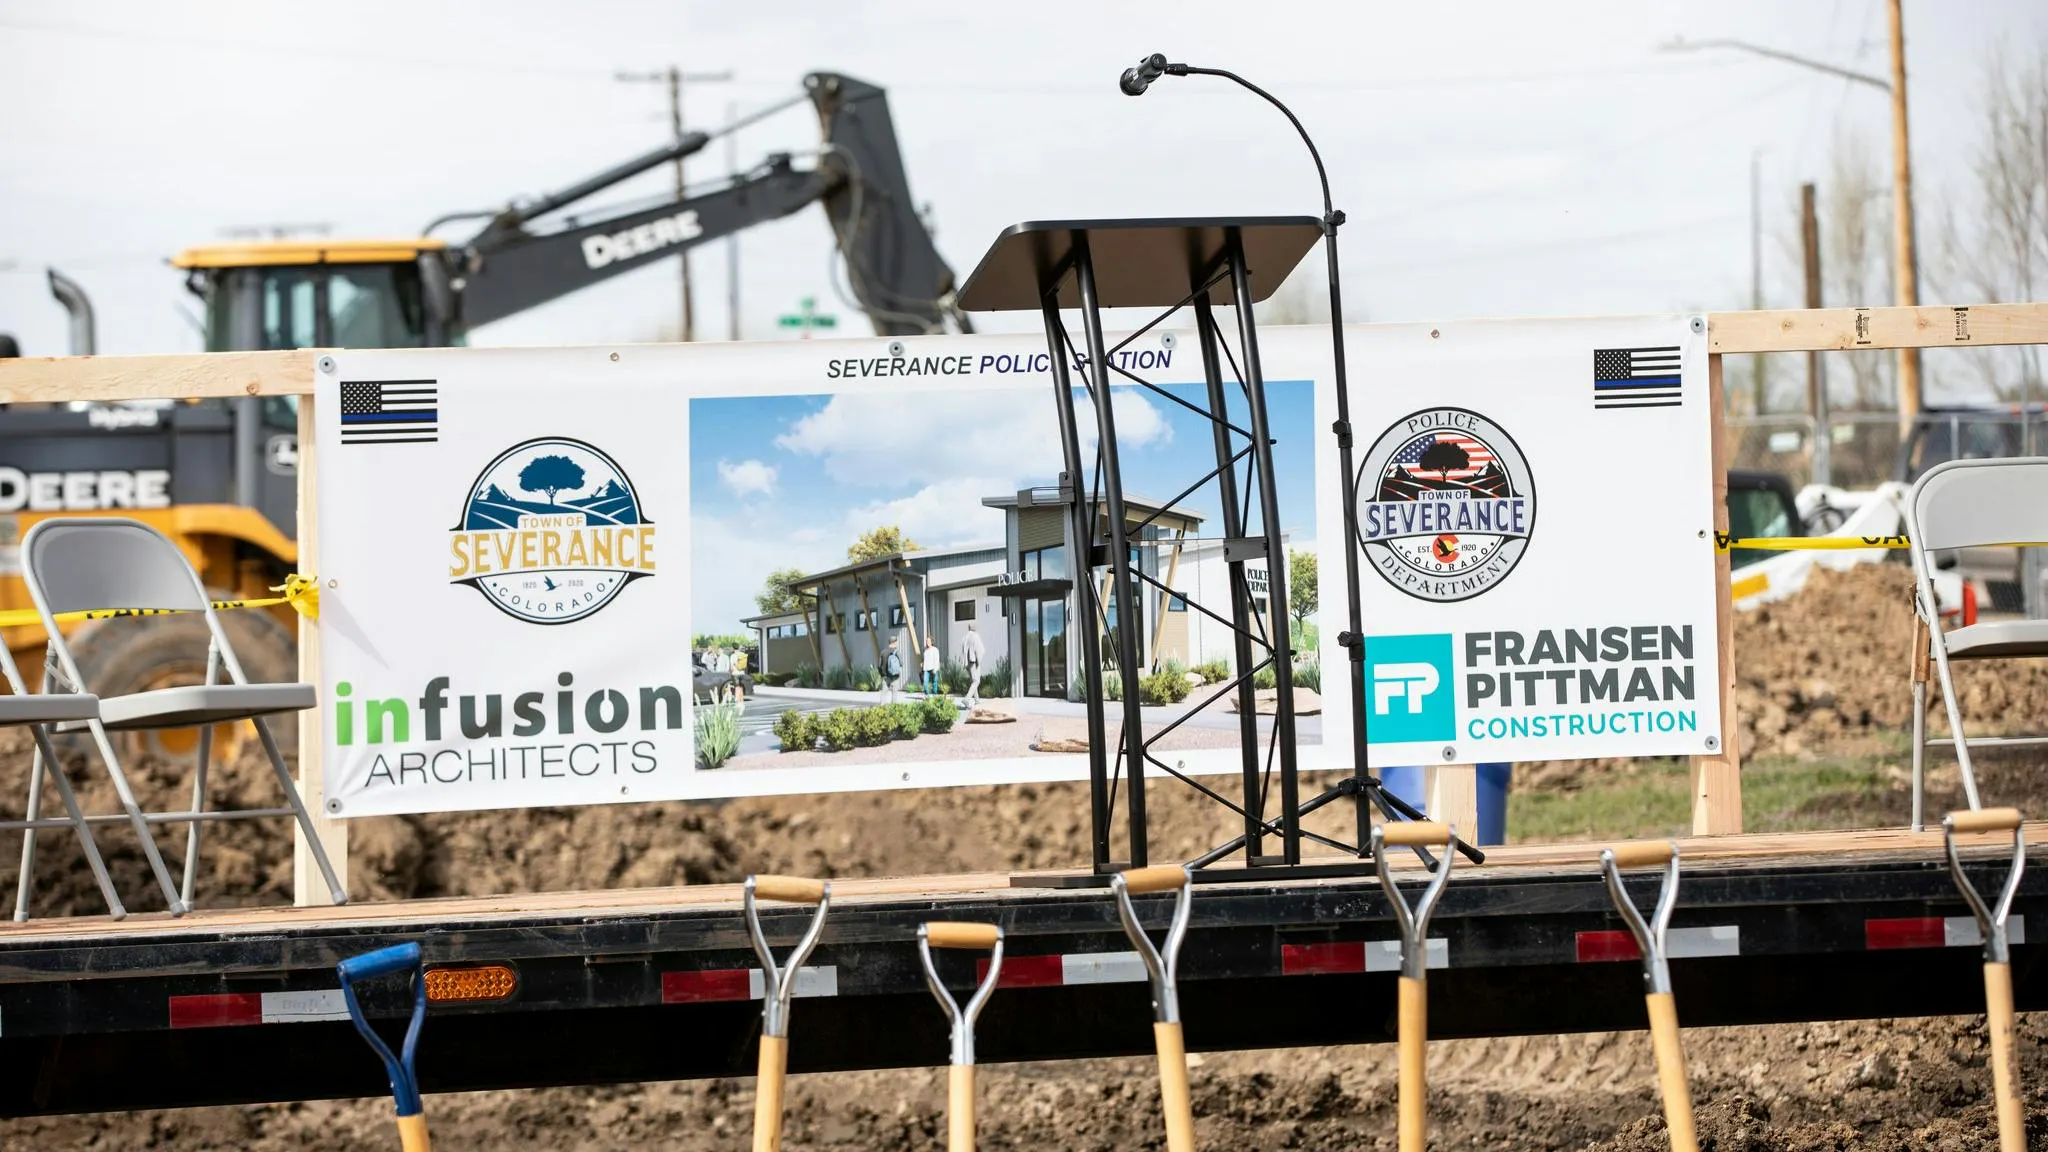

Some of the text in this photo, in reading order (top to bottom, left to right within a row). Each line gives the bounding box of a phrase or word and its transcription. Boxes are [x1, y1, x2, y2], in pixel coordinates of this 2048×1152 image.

[581, 209, 704, 269] DEERE
[827, 355, 973, 378] SEVERANCE
[979, 353, 1053, 374] POLIC
[1407, 412, 1480, 434] POLICE
[0, 466, 171, 512] DEERE
[1421, 490, 1469, 501] TOWN OF
[521, 516, 584, 529] TOWN OF
[1365, 500, 1525, 539] SEVERANCE
[449, 527, 656, 577] SEVERANCE
[1404, 547, 1488, 571] COLORADO
[1461, 543, 1477, 552] 1920
[998, 569, 1034, 587] POLICE
[1381, 551, 1511, 596] DEPARTMENT
[499, 582, 606, 612] COLORADO
[1465, 624, 1694, 668] FRANSEN
[1466, 665, 1695, 709] PITTMAN
[335, 671, 683, 746] infusion
[1468, 710, 1697, 740] CONSTRUCTION
[364, 740, 658, 788] ARCHITECTS
